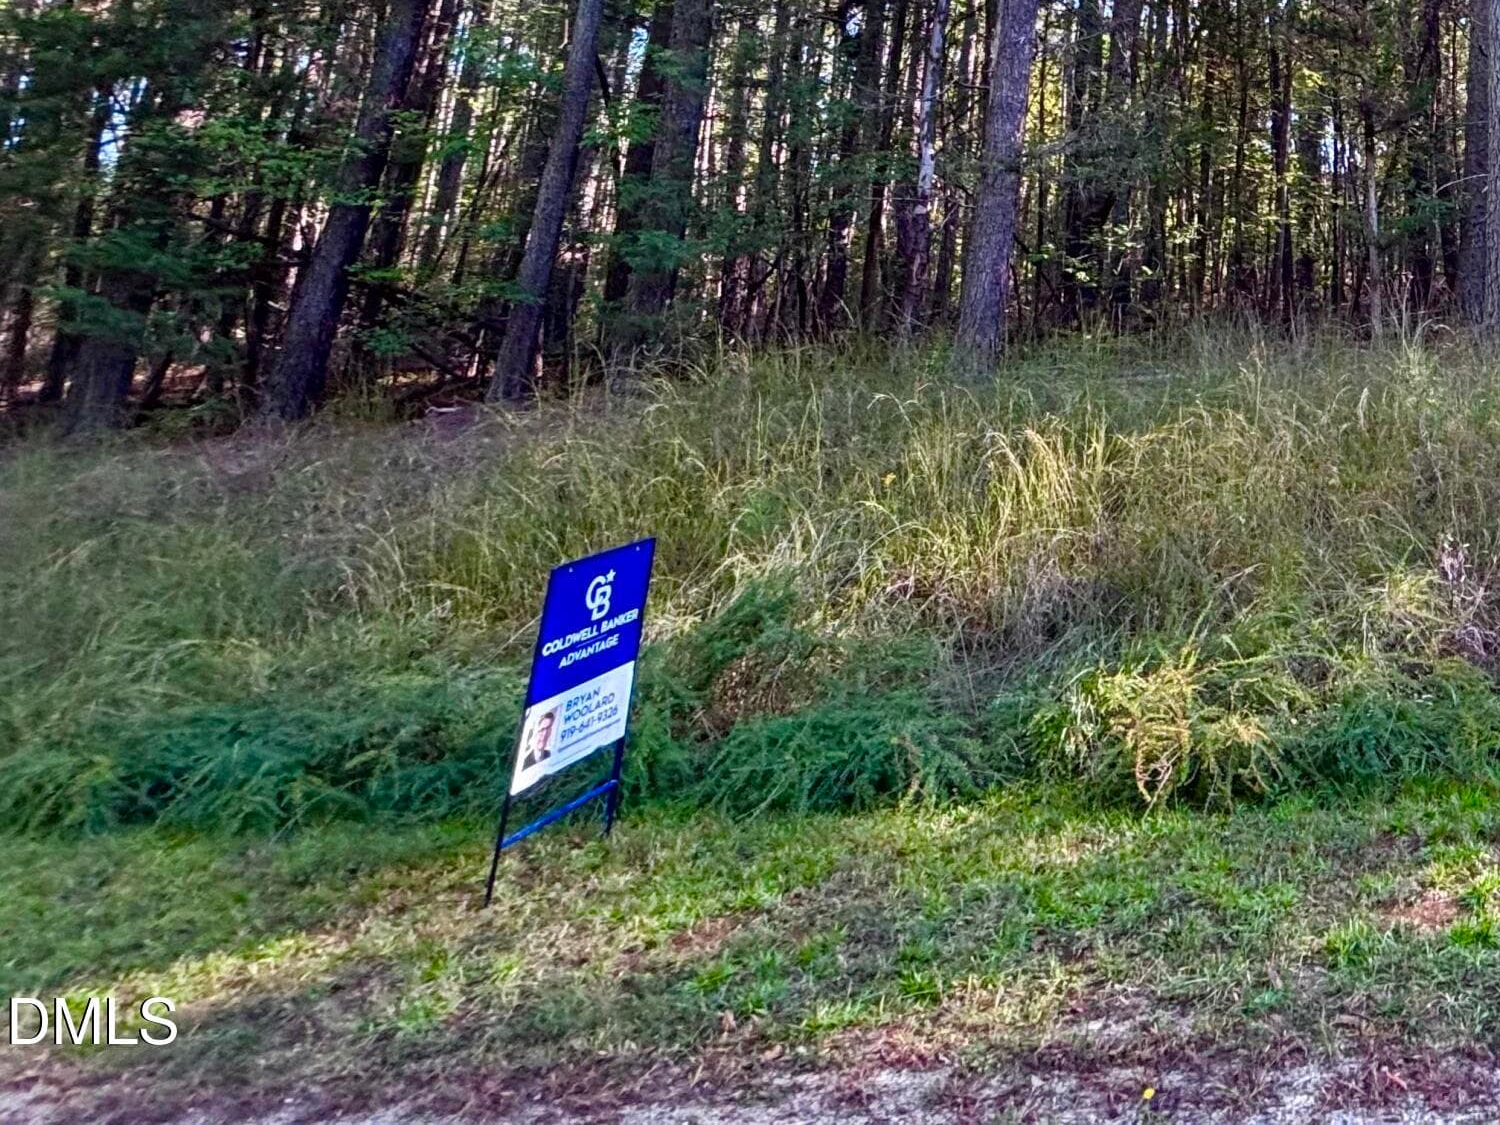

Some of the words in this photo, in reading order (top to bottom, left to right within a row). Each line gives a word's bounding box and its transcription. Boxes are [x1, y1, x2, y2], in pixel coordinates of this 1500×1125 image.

[542, 624, 599, 657] COLDWELL
[600, 608, 639, 634] BANKER
[558, 633, 620, 669] ADVANTAGE
[564, 692, 615, 723] WOOLARD
[565, 686, 601, 712] BRYAN
[560, 704, 618, 742] 919-641-9326
